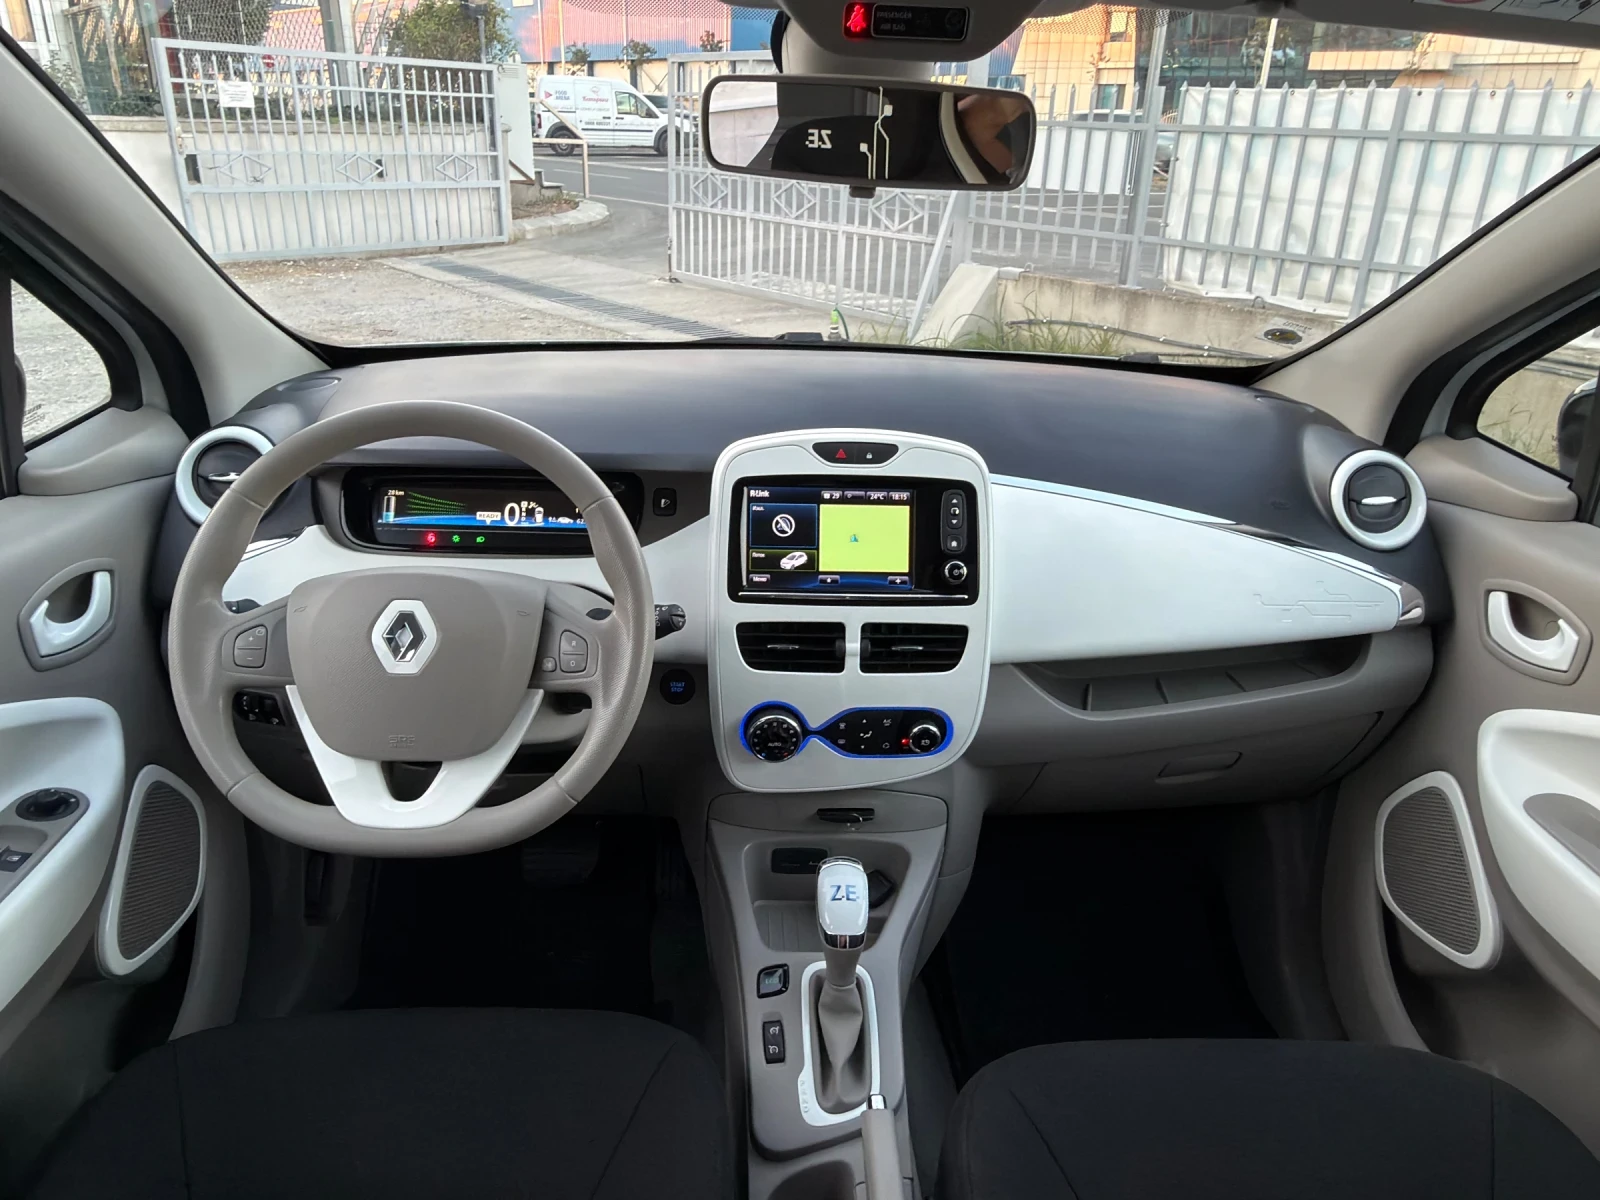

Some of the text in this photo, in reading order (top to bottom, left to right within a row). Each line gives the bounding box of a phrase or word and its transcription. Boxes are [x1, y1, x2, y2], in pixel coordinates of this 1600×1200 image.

[877, 11, 912, 19] PASSENGER
[750, 489, 770, 497] R-Link
[504, 502, 520, 527] 0
[830, 884, 860, 902] Z.E.
